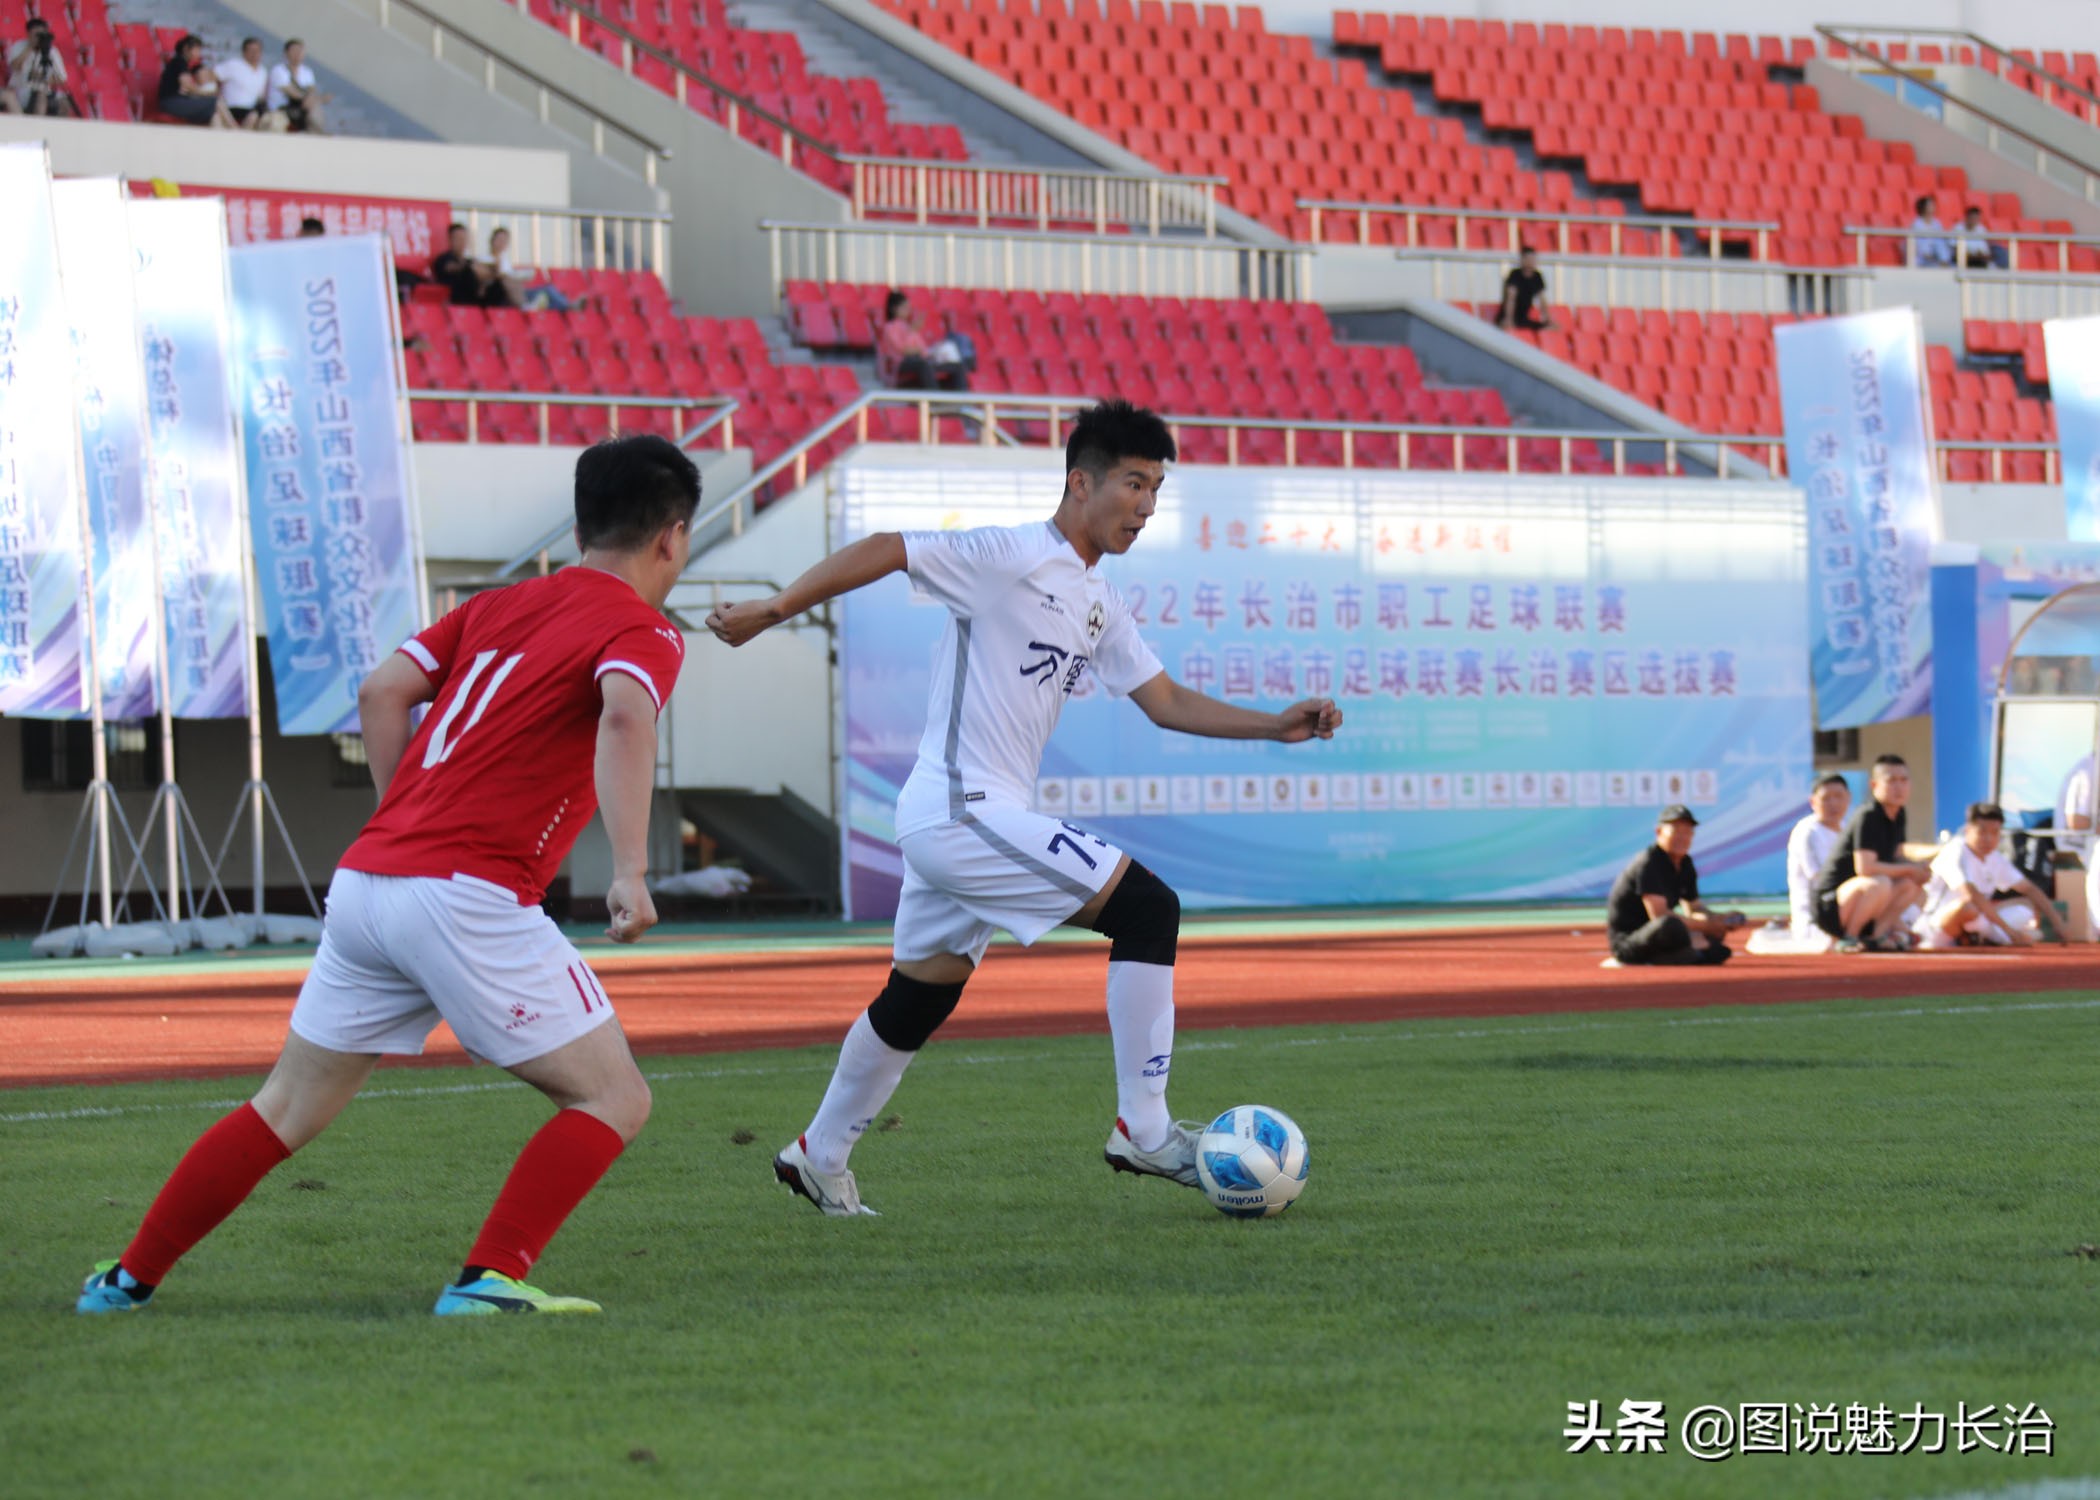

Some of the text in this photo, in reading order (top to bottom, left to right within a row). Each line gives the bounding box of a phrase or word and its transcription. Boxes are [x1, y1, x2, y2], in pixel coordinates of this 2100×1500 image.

[1195, 513, 1341, 552] 喜迎二十大
[1183, 645, 1737, 697] 中国城市足球联赛长治赛区选拔赛
[421, 649, 525, 769] 11
[1047, 820, 1106, 871] 7
[567, 960, 604, 1014] 11
[1217, 1193, 1265, 1206] molten
